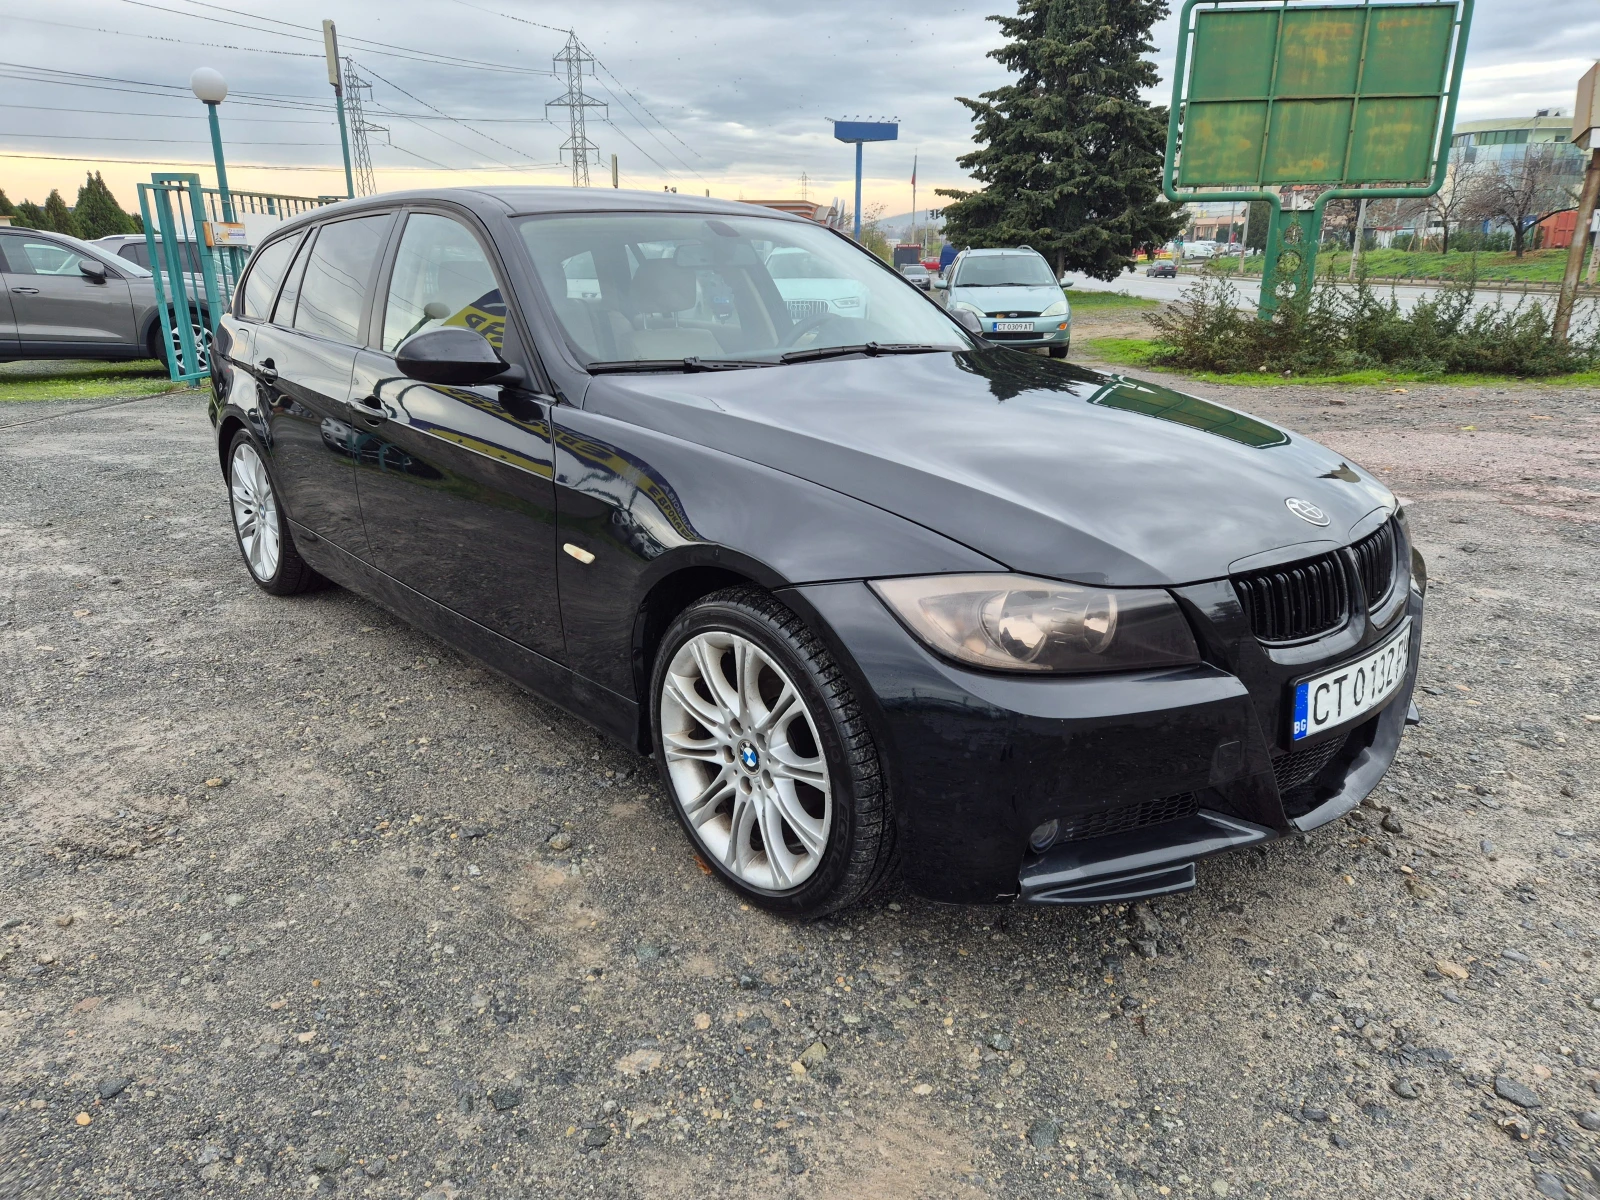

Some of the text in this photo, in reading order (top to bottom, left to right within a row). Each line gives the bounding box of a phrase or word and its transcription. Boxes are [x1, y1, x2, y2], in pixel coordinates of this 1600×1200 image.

[1313, 674, 1348, 726] CT
[1354, 647, 1394, 706] 0132
[1294, 719, 1307, 735] BG
